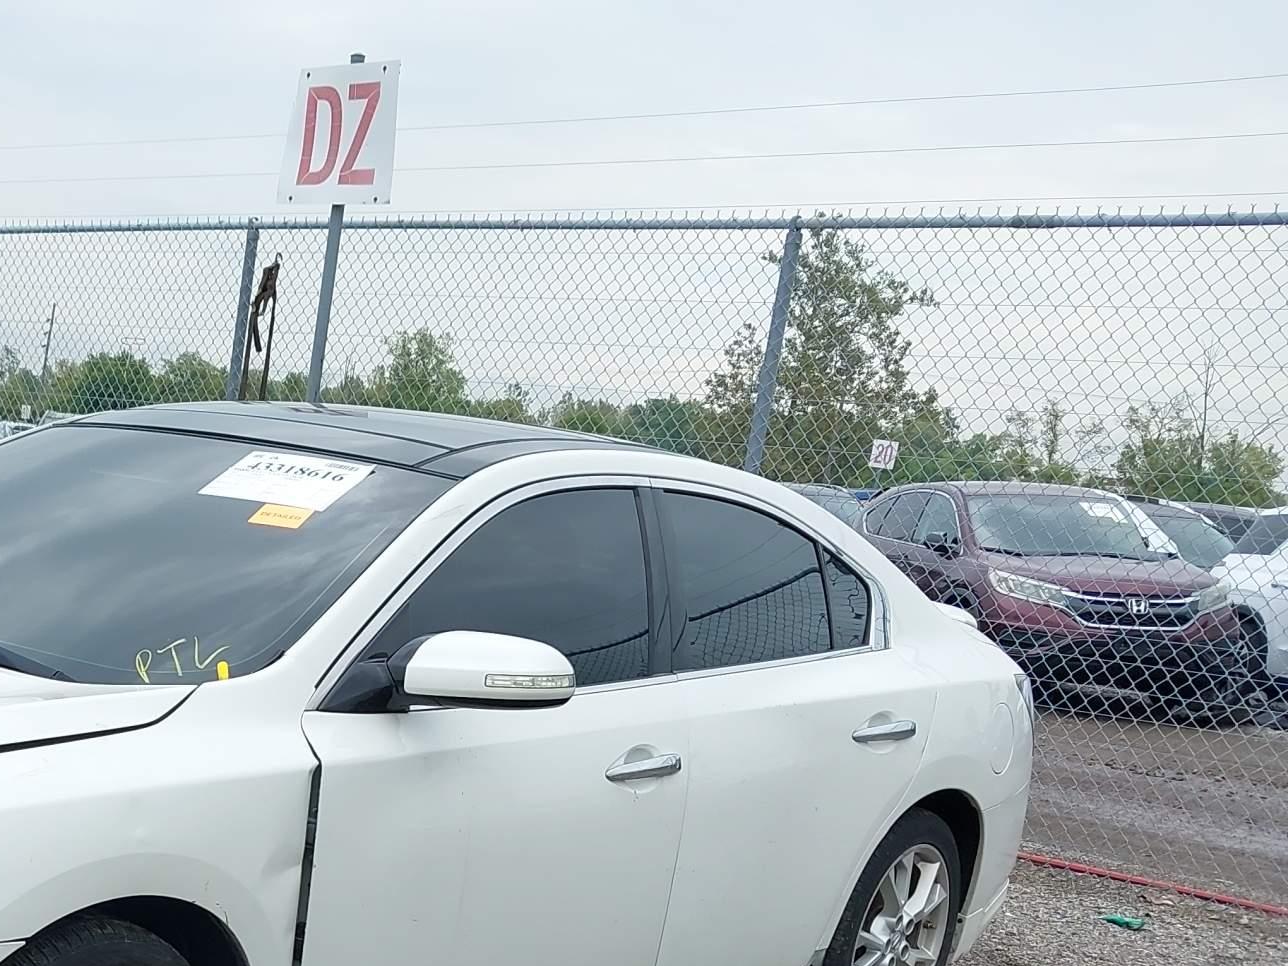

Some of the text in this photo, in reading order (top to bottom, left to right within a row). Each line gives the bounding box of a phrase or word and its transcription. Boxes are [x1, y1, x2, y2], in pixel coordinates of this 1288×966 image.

[295, 81, 382, 186] DZ
[873, 443, 894, 465] 20
[247, 461, 346, 482] 43318616
